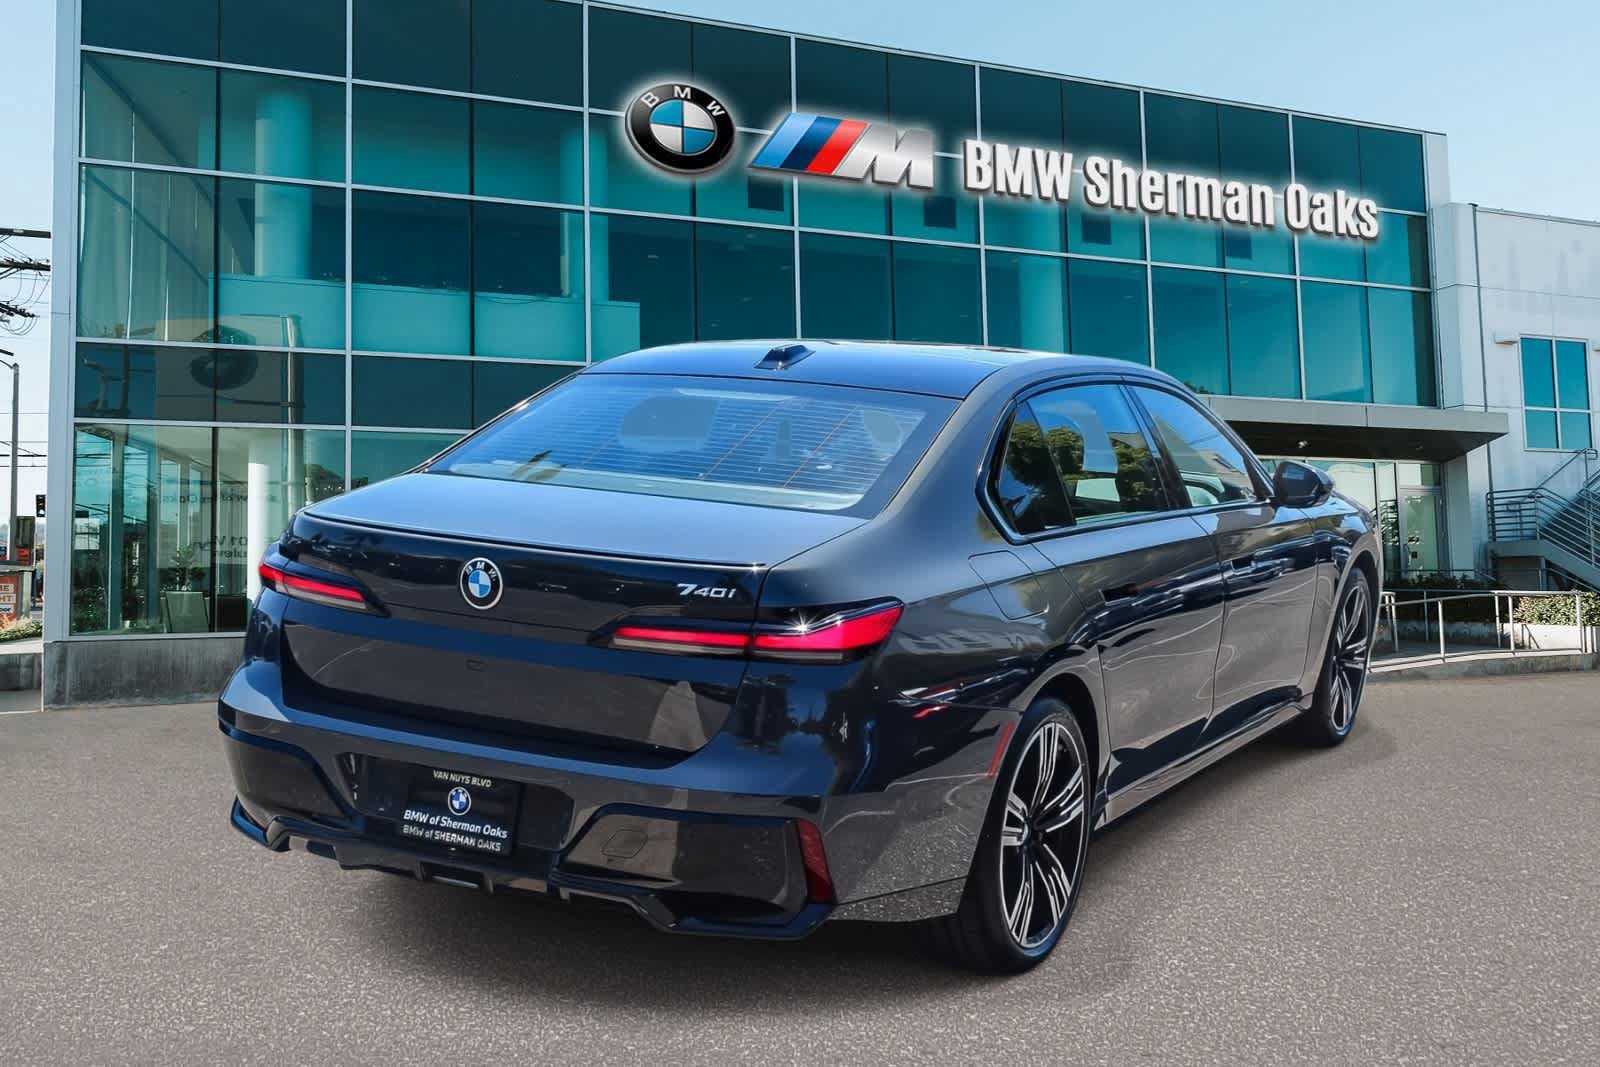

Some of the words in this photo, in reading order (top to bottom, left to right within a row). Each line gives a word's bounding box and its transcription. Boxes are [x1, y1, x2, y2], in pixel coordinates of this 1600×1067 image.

[641, 86, 725, 117] BMW
[964, 139, 1074, 201] BMW
[1083, 155, 1275, 227] Sherman
[1284, 183, 1379, 240] Oaks
[677, 583, 737, 599] 740i
[433, 769, 449, 780] VAN
[450, 773, 471, 784] NUYS
[471, 776, 492, 788] BLVD
[403, 809, 429, 824] BMW
[429, 815, 441, 826] of
[440, 816, 481, 834] Sherman
[482, 824, 508, 839] Oaks
[403, 824, 424, 838] BMW
[424, 828, 434, 839] of
[434, 830, 476, 847] SHERMAN
[477, 839, 502, 852] OAKS
